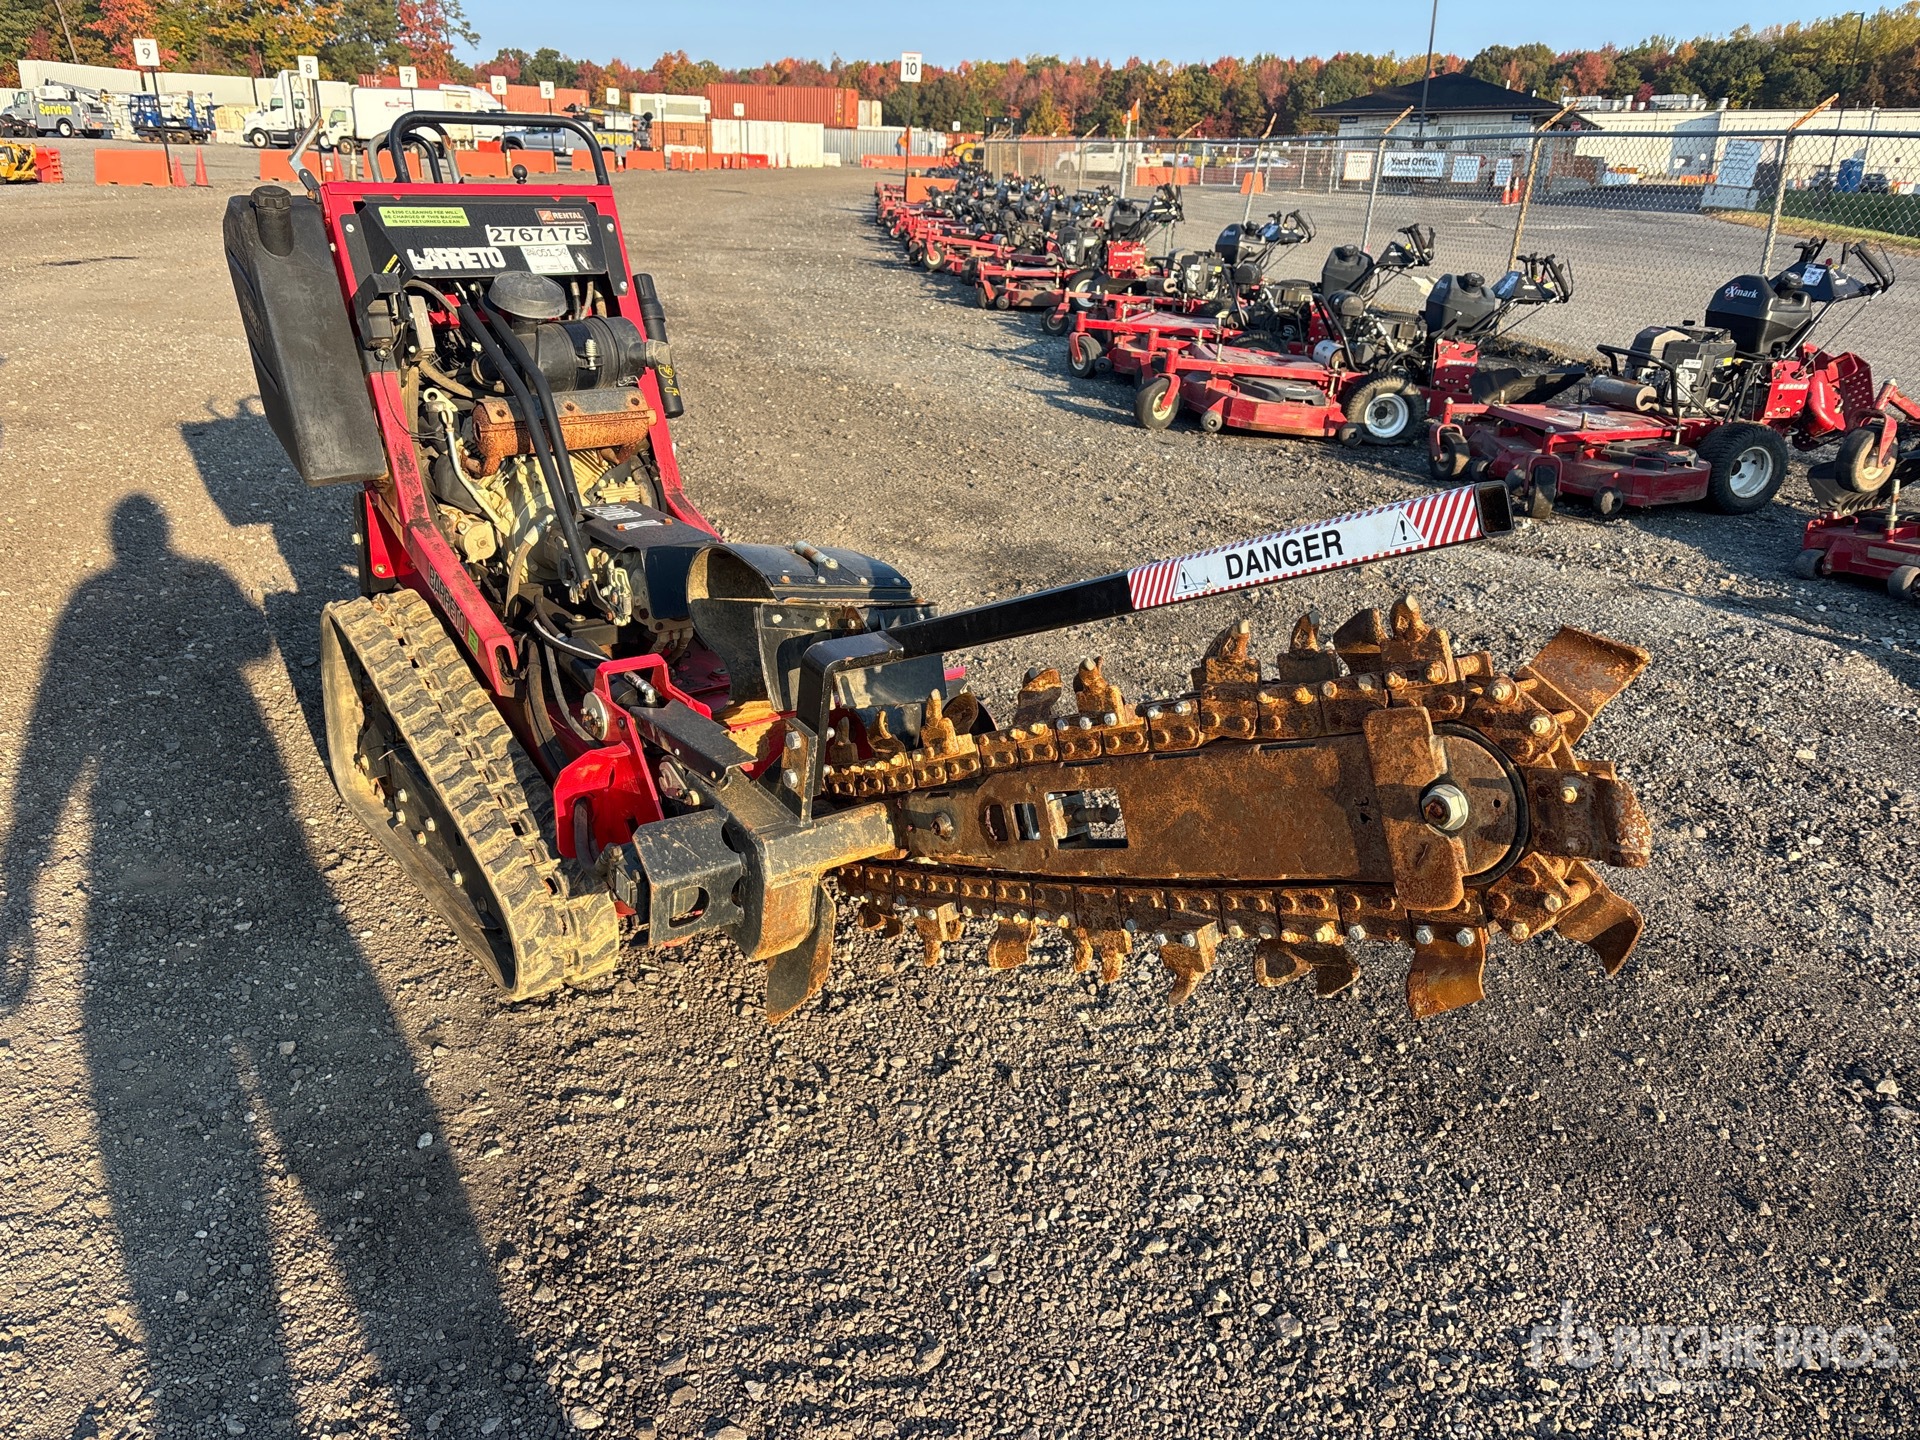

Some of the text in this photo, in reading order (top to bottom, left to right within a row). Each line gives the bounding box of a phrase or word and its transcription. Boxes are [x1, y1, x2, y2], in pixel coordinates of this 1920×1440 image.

[142, 47, 151, 59] 9
[305, 63, 313, 73] 8
[905, 62, 917, 75] 10
[404, 73, 411, 82] 7
[496, 80, 503, 90] 6
[38, 102, 73, 115] Service
[594, 133, 633, 146] ervice
[1391, 156, 1438, 166] Yard Office
[552, 211, 584, 220] RENTAL
[489, 227, 589, 242] 2767175
[1225, 529, 1344, 580] DANGER
